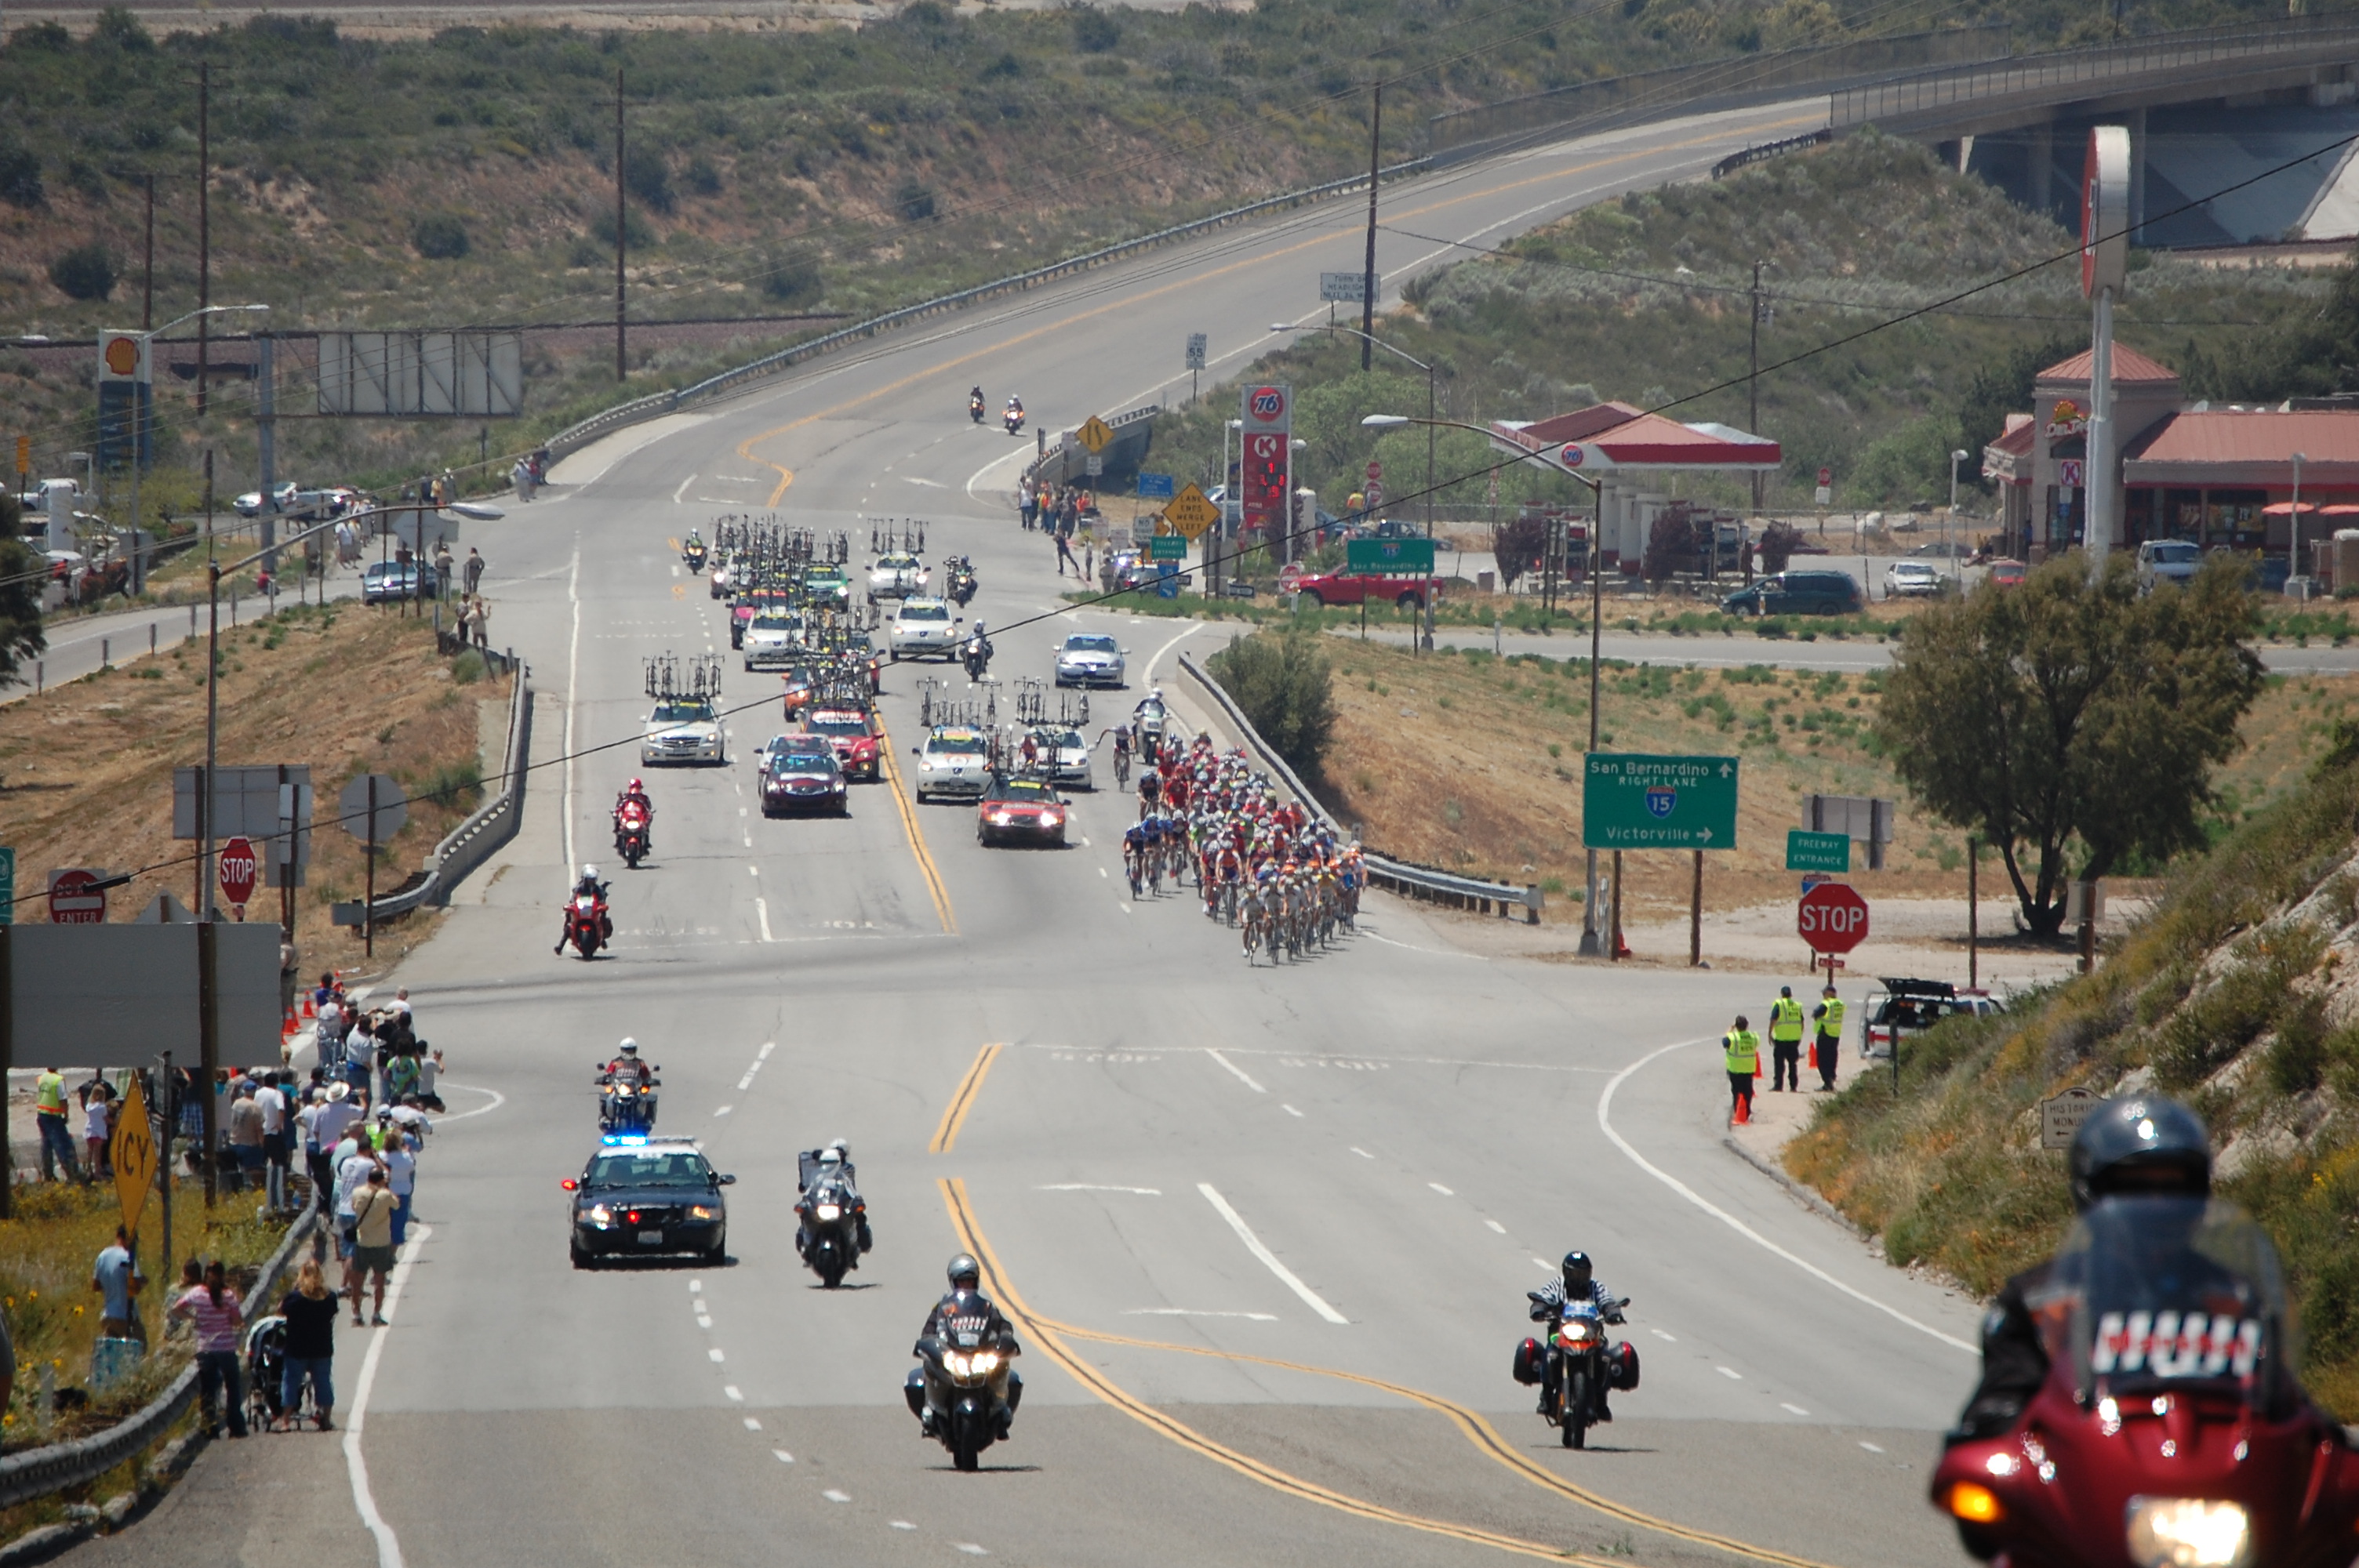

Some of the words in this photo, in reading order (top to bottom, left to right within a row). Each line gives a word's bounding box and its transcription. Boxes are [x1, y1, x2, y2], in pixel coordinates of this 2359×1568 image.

[1255, 394, 1279, 413] 76
[1258, 438, 1275, 456] K
[1564, 449, 1580, 462] 76
[1371, 562, 1416, 571] Bernardino
[1590, 761, 1619, 775] San
[1626, 762, 1710, 776] Bernardino
[1619, 776, 1659, 786] RIGHT
[1663, 777, 1698, 787] LANE
[1652, 796, 1670, 811] 15
[1606, 826, 1690, 840] Victorville
[1797, 838, 1839, 851] FREEWAY
[1794, 854, 1843, 866] ENTRANCE
[221, 857, 254, 884] STOP
[56, 884, 73, 895] DO
[59, 912, 96, 924] ENTER
[1801, 904, 1864, 933] STOP
[115, 1130, 150, 1180] ICY
